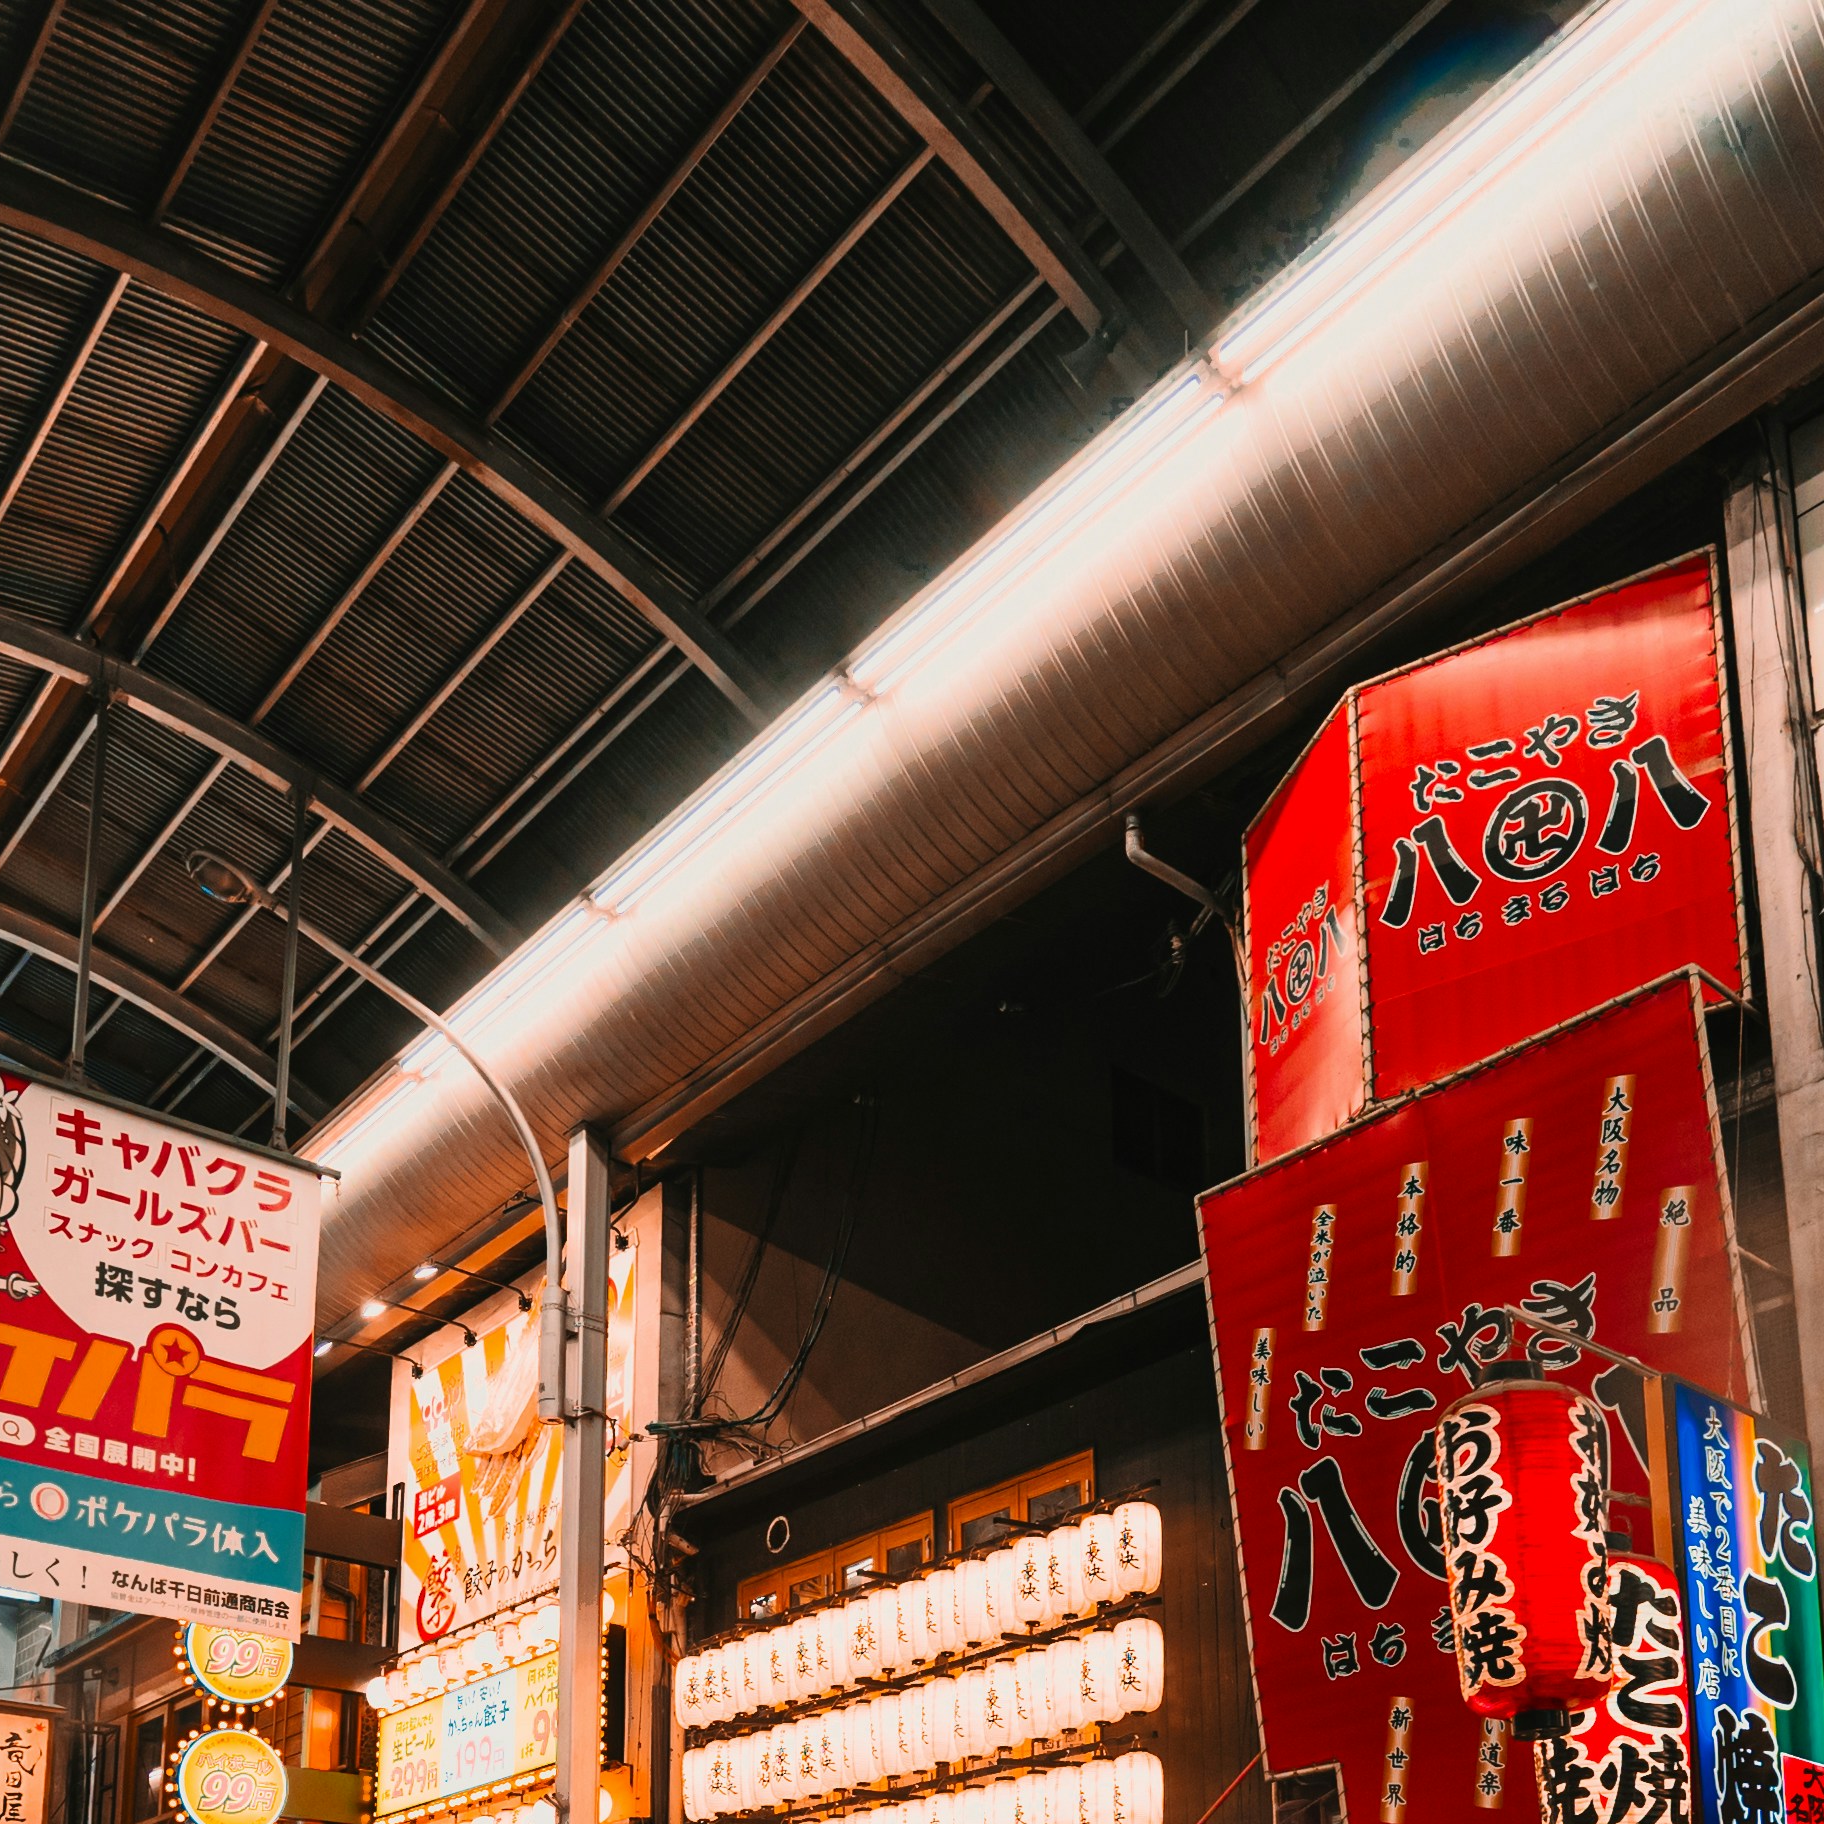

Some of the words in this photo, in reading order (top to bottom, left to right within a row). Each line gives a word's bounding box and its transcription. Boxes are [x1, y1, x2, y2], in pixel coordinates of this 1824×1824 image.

[1410, 690, 1640, 813] たこやき
[1418, 911, 1482, 954] はち
[1503, 881, 1569, 926] まる
[1590, 853, 1660, 897] はち
[1494, 1130, 1532, 1238] 味一番
[1591, 1083, 1631, 1211] 大阪名物
[1307, 1210, 1335, 1323] 全米が泣いた
[1395, 1176, 1424, 1276] 本格的
[1652, 1200, 1692, 1315] 絶品
[95, 1261, 242, 1331] 探すなら
[1247, 1338, 1272, 1440] 美味しい
[1290, 1273, 1598, 1450] たこやき
[44, 1425, 196, 1483] 全国展開中!
[77, 1496, 279, 1564] ポケパラ体入
[1437, 1404, 1529, 1690] お好み焼
[1702, 1404, 1742, 1681] 大阪で2番目に
[112, 1568, 291, 1620] なんば千日前通商店会
[1685, 1494, 1722, 1702] 美味しい店
[205, 1633, 286, 1679] 99円
[196, 1770, 278, 1815] 99円
[197, 1752, 274, 1777] ハイボール
[389, 1758, 439, 1799] 299円
[392, 1729, 437, 1763] 生ビール
[1384, 1705, 1415, 1809] 新世界
